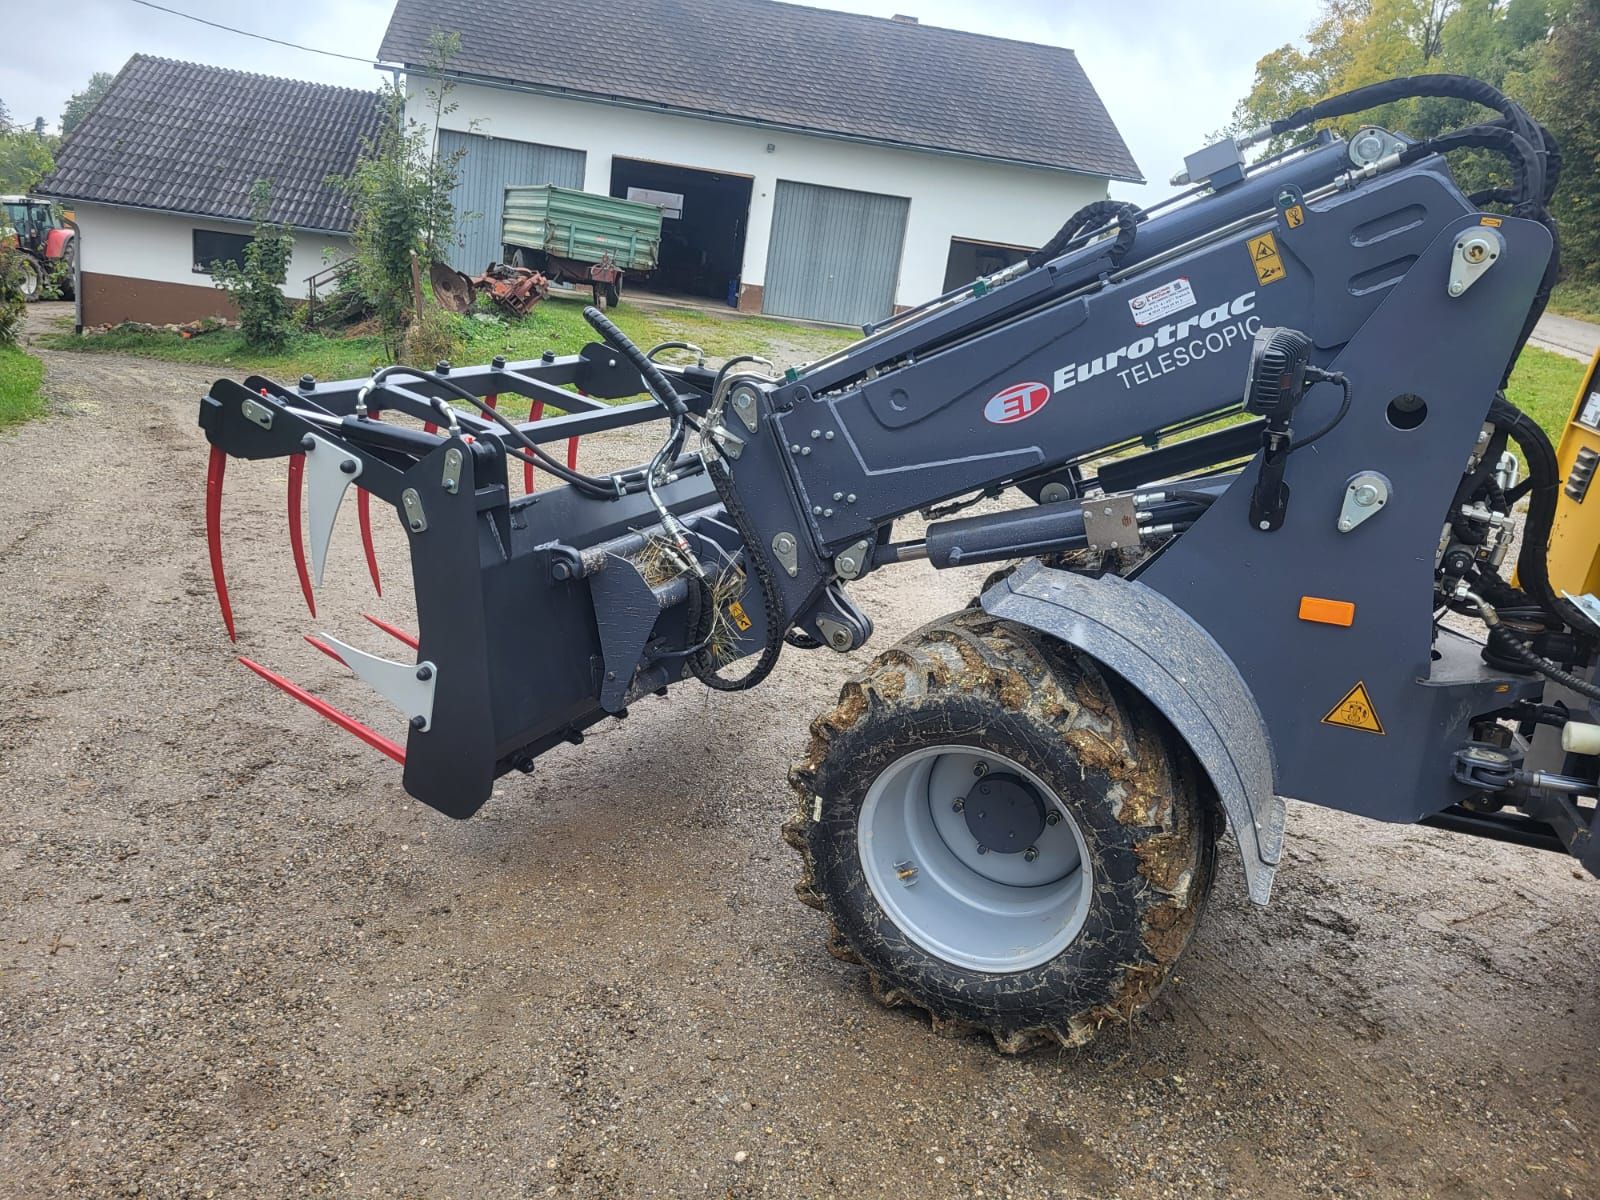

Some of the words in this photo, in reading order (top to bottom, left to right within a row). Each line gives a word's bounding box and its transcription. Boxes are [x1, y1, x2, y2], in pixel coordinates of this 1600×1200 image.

[1053, 290, 1256, 394] Eurotrac
[1116, 315, 1261, 389] TELESCOPIC
[985, 383, 1046, 422] ET
